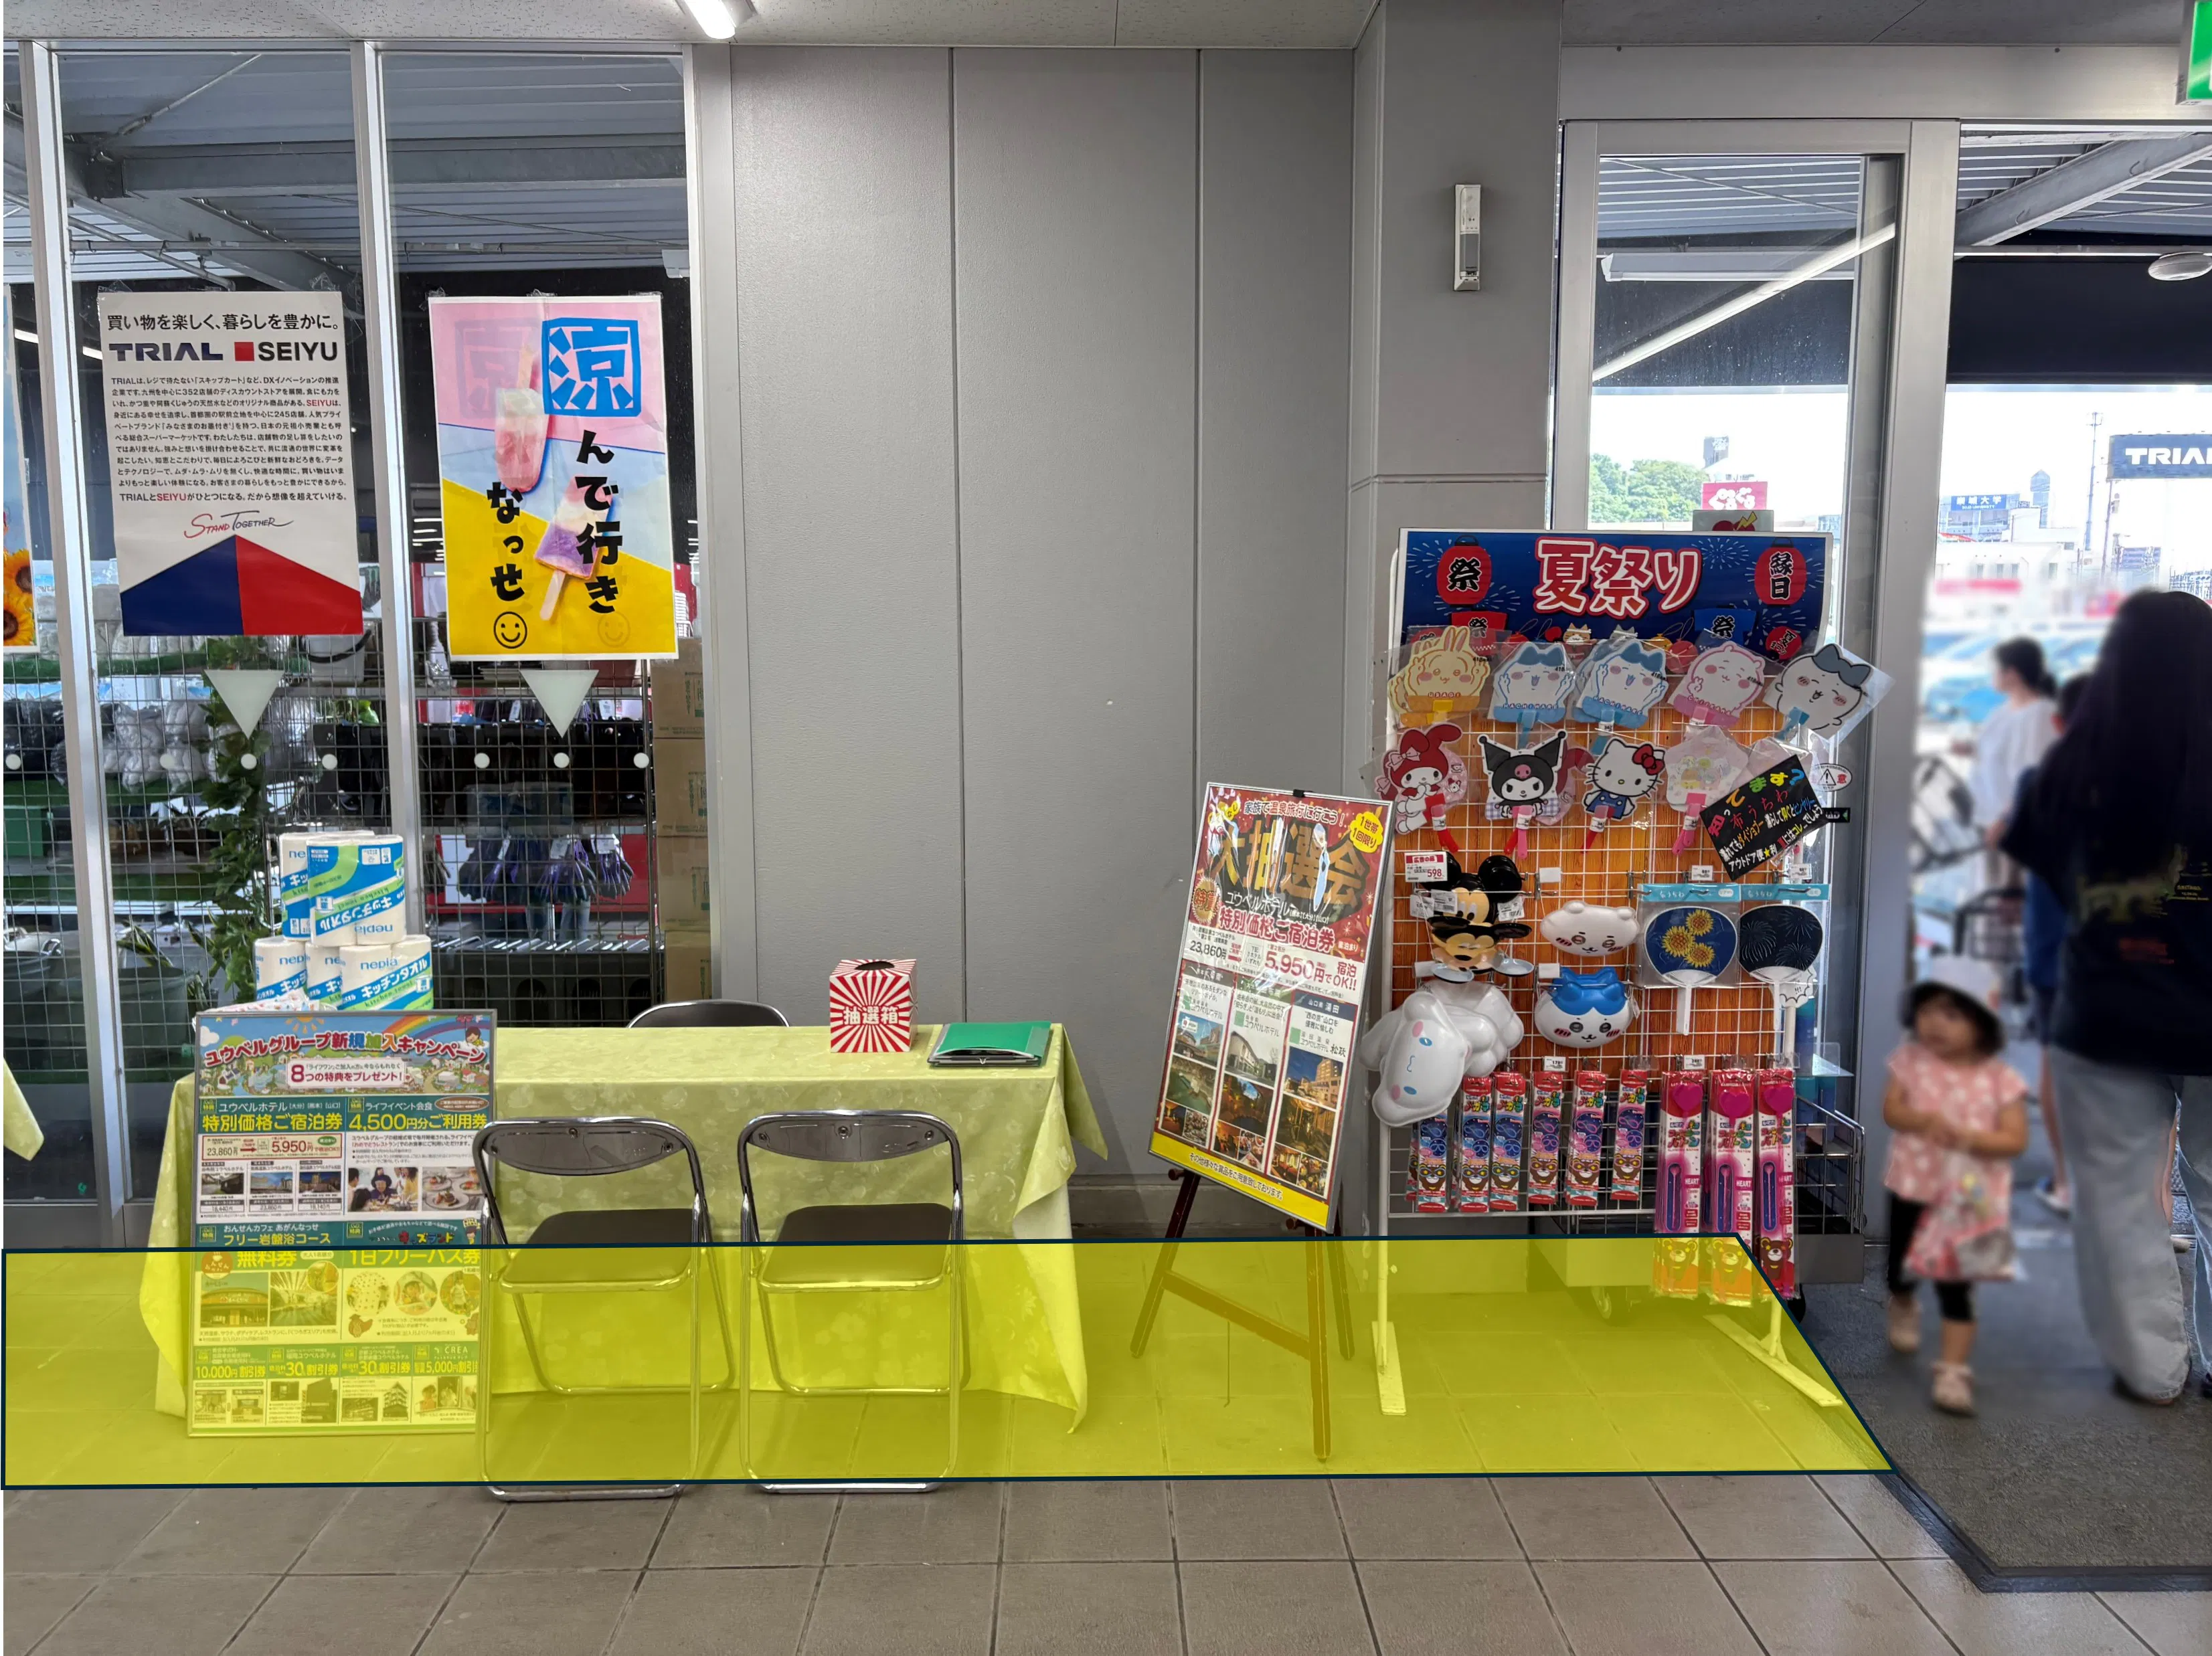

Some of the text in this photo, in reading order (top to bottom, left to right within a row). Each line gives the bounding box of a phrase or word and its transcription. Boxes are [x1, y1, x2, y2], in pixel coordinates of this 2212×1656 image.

[107, 314, 339, 331] 買い物を楽しく、暮らしを豊かに。
[109, 342, 337, 361] TRIAL SEIYU
[486, 481, 525, 602] なっせ
[1447, 557, 1482, 591] 祭
[1535, 537, 1700, 618] 夏祭り
[1769, 551, 1794, 600] 縁日
[1711, 615, 1735, 638] 祭
[1593, 696, 1643, 716] HACHIWARE
[1360, 816, 1379, 834] 1世帯
[1352, 828, 1377, 849] 1回限り
[1209, 818, 1364, 904] 大抽選会
[1427, 868, 1442, 877] 598
[1225, 892, 1290, 916] ユウベルホテル
[319, 896, 392, 932] キッチンタオル
[354, 924, 393, 933] nepia
[1219, 907, 1335, 953] 特別価格ご宿泊券
[360, 958, 398, 970] nepia
[1337, 961, 1357, 978] 宿泊
[361, 958, 428, 998] キッチンタオル
[843, 1006, 899, 1025] 抽選箱
[1244, 1020, 1280, 1037] ユウベルホテル
[205, 1032, 487, 1067] ユウベルグループ新規加入キャンペーン
[219, 1103, 288, 1113] ユウベルホテル
[365, 1101, 433, 1111] ライフイベント会食
[202, 1113, 343, 1132] 特別価格ご宿泊券
[349, 1113, 487, 1131] 4,500円分ご利用券
[224, 1224, 319, 1232] おんせんカフェ あがんなっせ
[224, 1232, 331, 1246] フリー岩盤浴コース
[237, 1251, 297, 1268] 無料券
[444, 1346, 468, 1354] CREA
